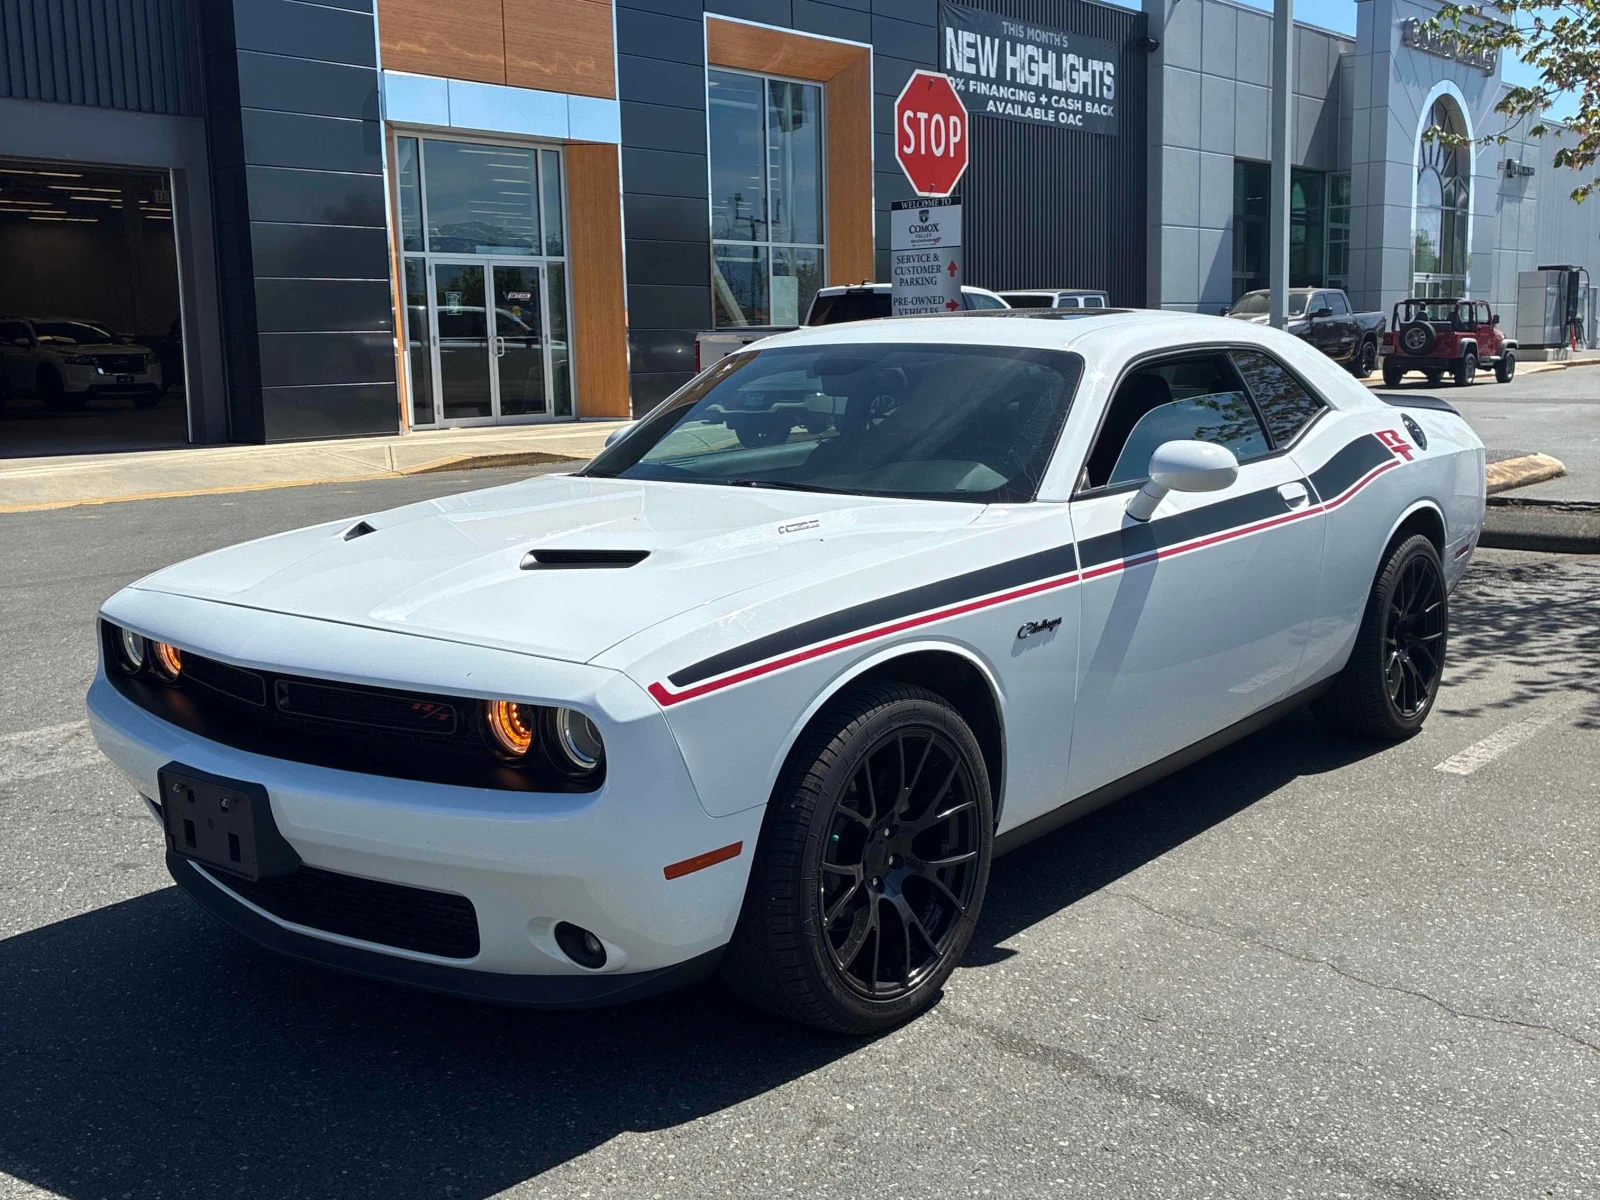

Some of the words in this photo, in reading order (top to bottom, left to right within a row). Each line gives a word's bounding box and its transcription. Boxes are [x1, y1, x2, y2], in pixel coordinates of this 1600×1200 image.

[1002, 21, 1025, 38] THIS
[1027, 27, 1069, 48] MONTH'S
[945, 27, 1000, 78] NEW
[1006, 41, 1115, 100] HIGHLIGHTS
[969, 80, 1036, 104] FINANCING
[1051, 95, 1082, 112] CASH
[1085, 103, 1114, 117] BACK
[986, 100, 1055, 122] AVAILABLE
[1058, 112, 1083, 126] OAC
[903, 109, 962, 158] STOP
[901, 198, 940, 210] WELCOME
[941, 197, 952, 206] TO
[908, 223, 940, 234] COMOX
[896, 253, 932, 265] SERVICE
[932, 252, 940, 262] &
[894, 264, 942, 276] CUSTOMER
[899, 275, 938, 287] PARKING
[893, 295, 945, 307] PRE-OWNED
